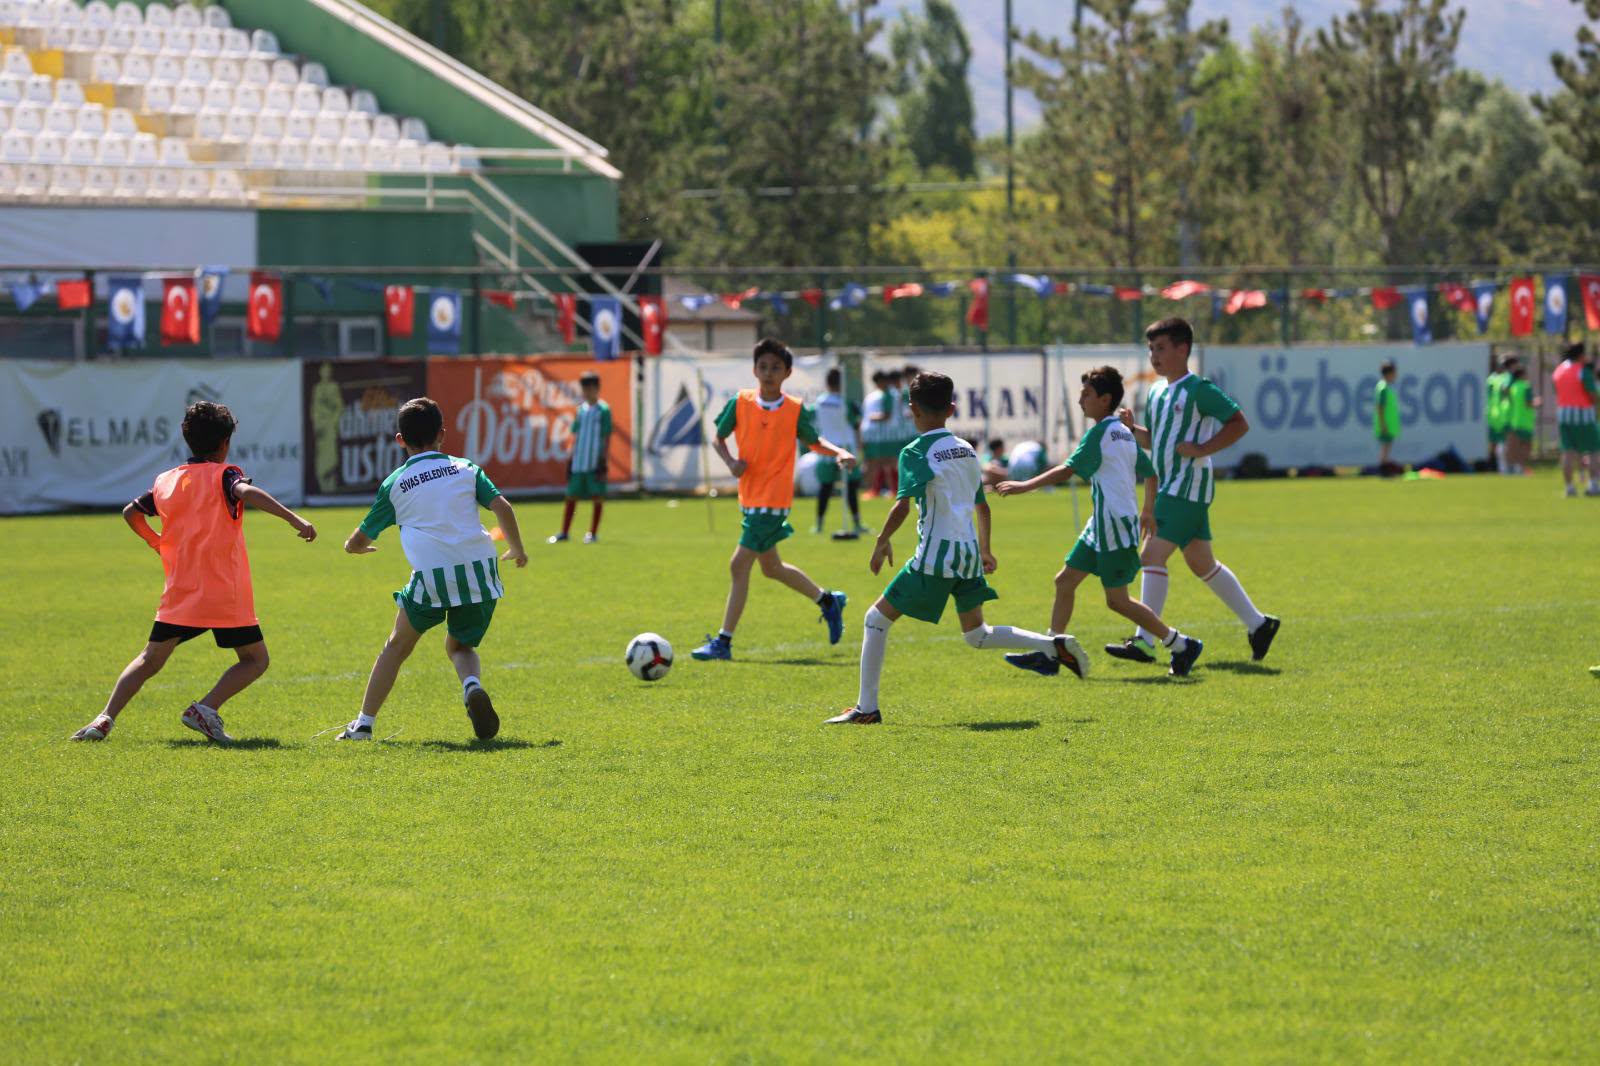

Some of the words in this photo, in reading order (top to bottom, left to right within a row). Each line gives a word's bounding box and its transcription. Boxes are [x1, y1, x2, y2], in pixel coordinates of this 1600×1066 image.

[1257, 354, 1481, 430] özbesan
[66, 416, 170, 448] ELMAS
[456, 398, 577, 467] Döne
[399, 475, 420, 494] SİVAS
